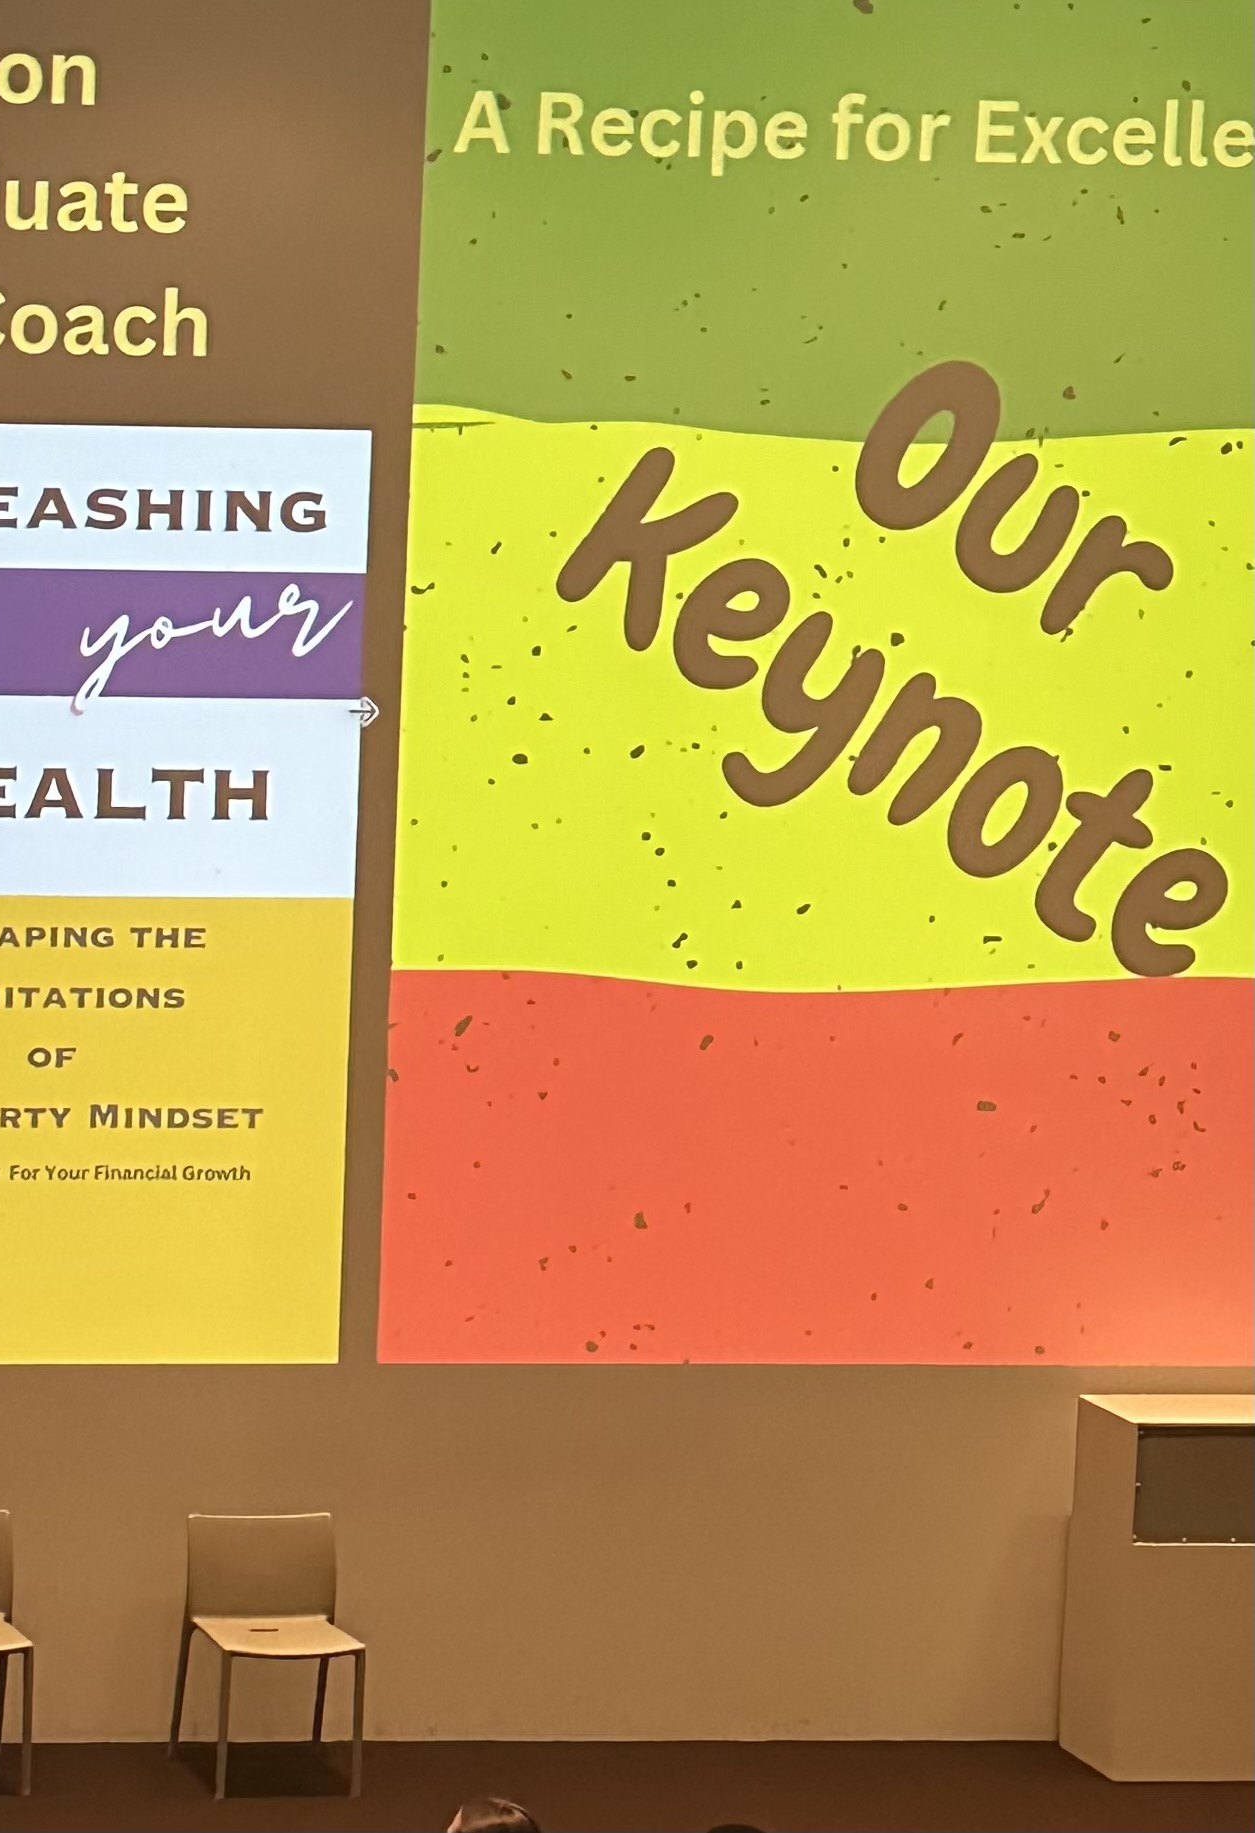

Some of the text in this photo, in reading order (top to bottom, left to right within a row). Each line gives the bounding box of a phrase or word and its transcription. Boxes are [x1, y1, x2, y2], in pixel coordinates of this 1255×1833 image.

[454, 91, 1255, 176] A Recipe for Excelle
[855, 360, 1173, 634] Our
[70, 584, 352, 715] your
[556, 447, 1228, 977] Keynote
[130, 926, 206, 949] THE
[27, 1047, 76, 1068] OF
[9, 1165, 39, 1181] For
[45, 1165, 89, 1182] Your
[94, 1165, 177, 1182] Financial
[182, 1165, 251, 1182] Growth
